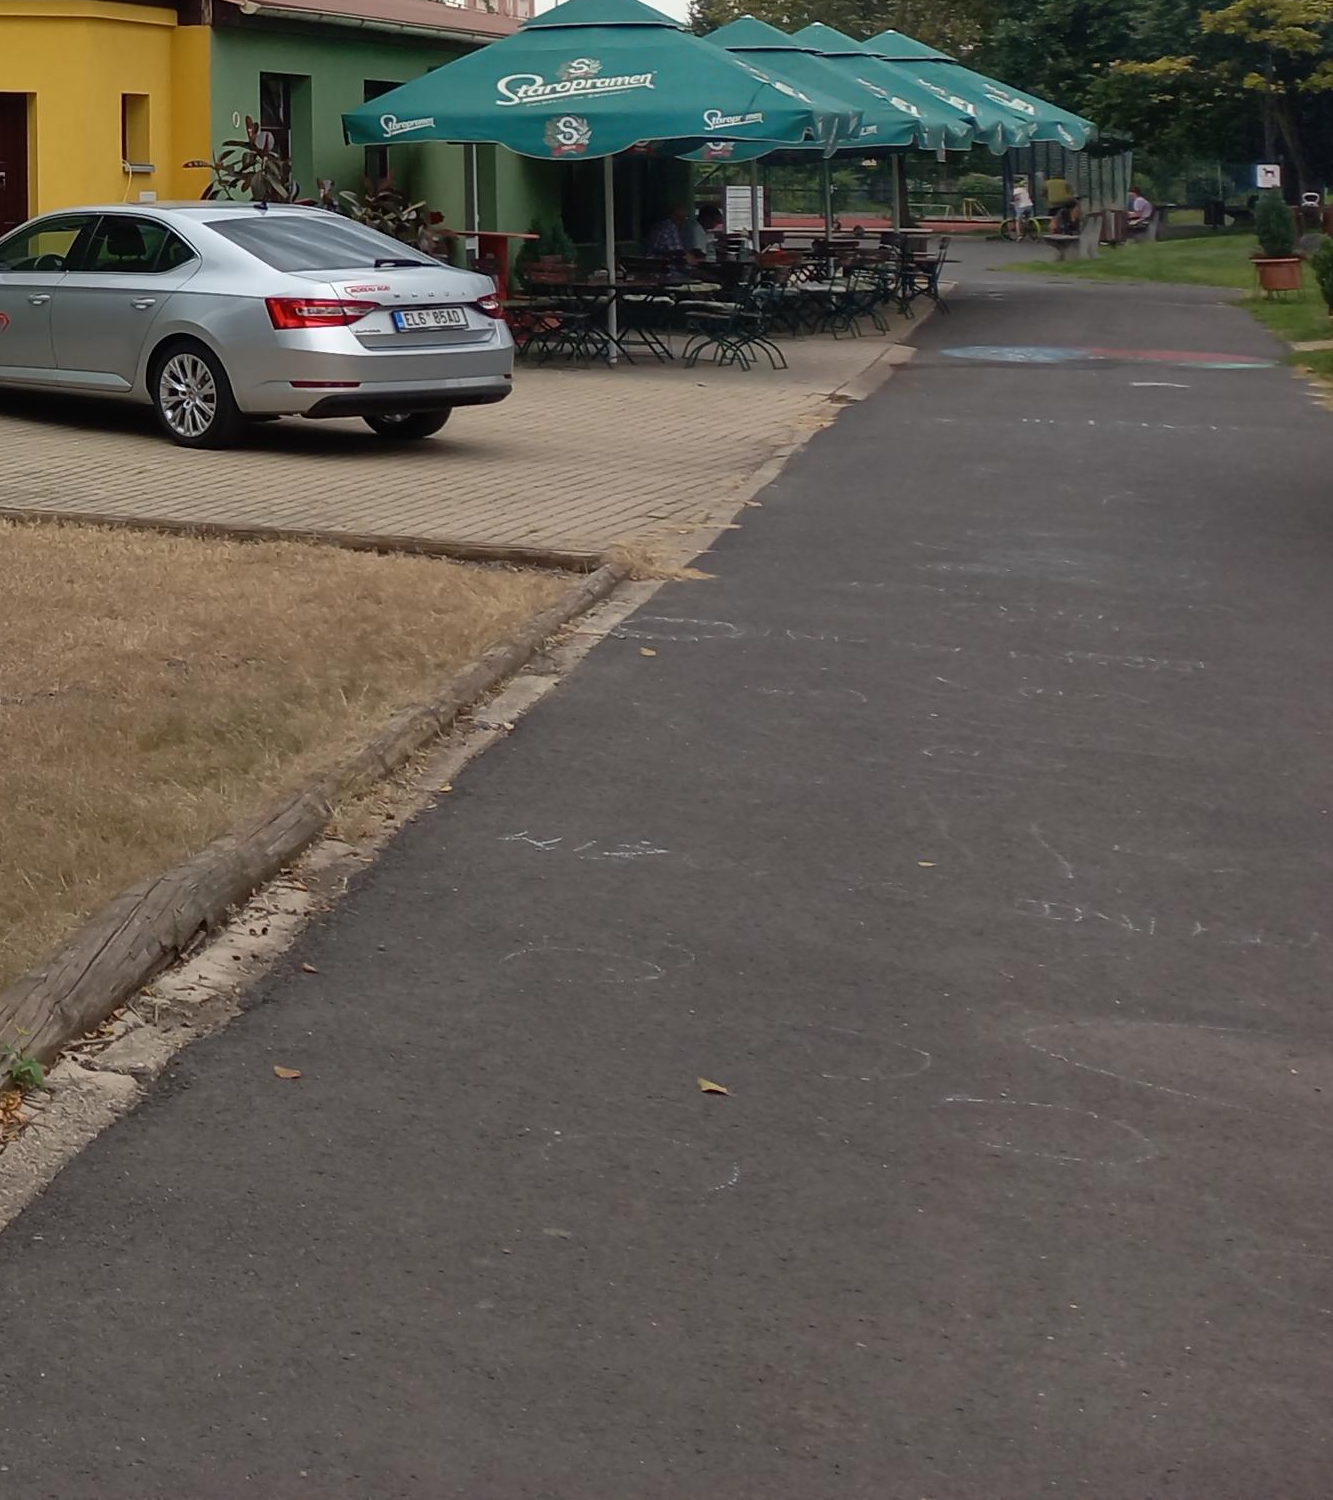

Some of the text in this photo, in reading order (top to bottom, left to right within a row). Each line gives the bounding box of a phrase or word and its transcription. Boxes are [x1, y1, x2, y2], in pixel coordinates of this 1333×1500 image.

[496, 73, 656, 106] Staropramen
[703, 109, 764, 131] Staroprmen
[404, 310, 461, 327] EL6 85AD
